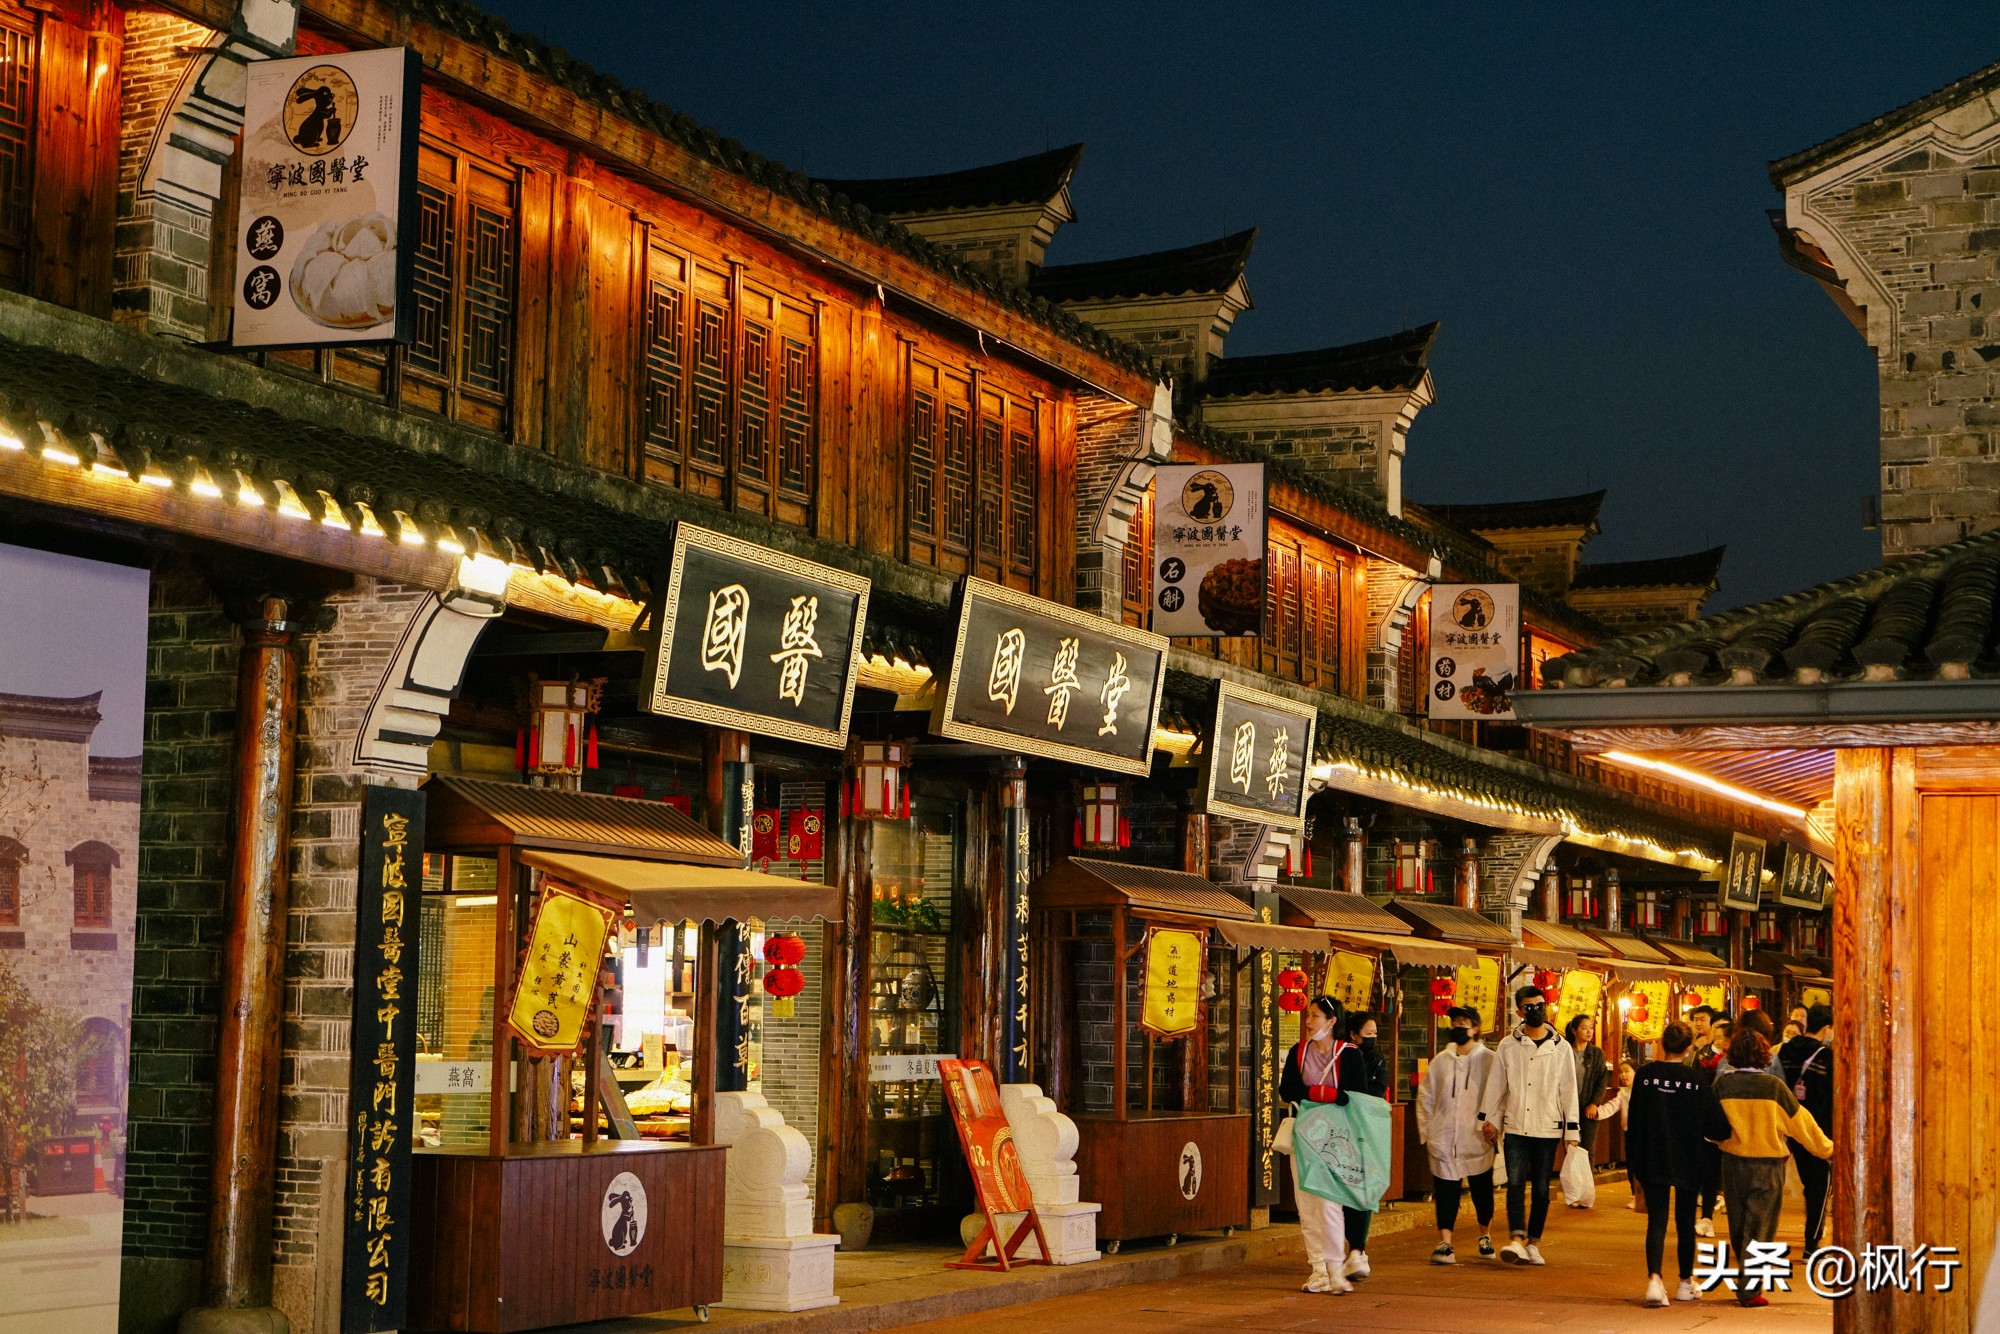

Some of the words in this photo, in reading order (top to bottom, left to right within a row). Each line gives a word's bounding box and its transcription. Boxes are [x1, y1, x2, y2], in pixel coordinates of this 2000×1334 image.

[267, 155, 369, 190] 寧波國醫堂
[1165, 964, 1178, 1018] 道地药材
